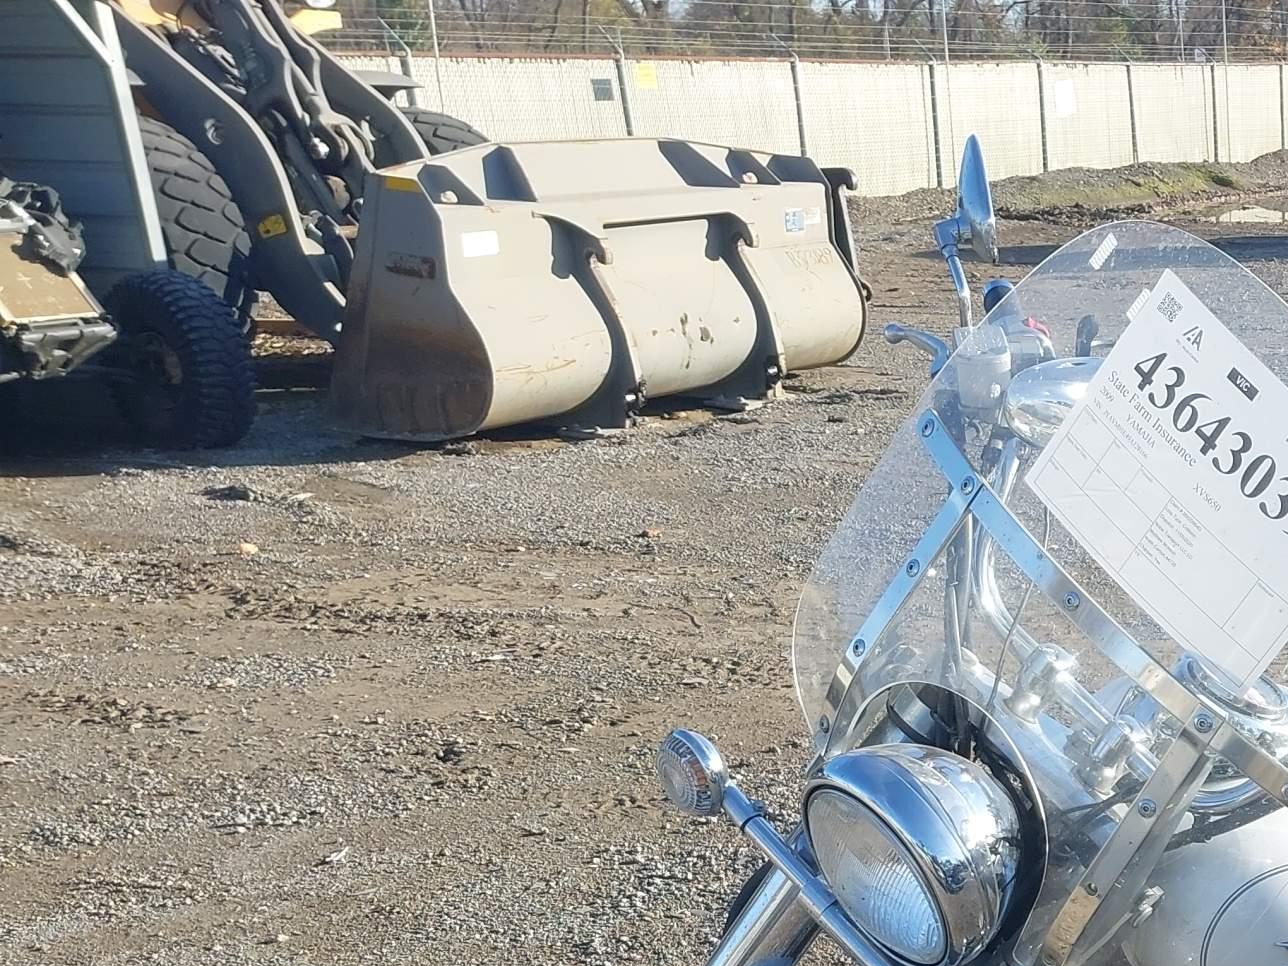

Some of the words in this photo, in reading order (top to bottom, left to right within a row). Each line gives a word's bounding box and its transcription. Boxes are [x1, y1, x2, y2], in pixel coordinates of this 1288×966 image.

[1236, 375, 1251, 391] VIC
[1107, 370, 1130, 397] State
[1128, 393, 1153, 423] Farm
[1151, 417, 1199, 467] Insurance
[1126, 413, 1156, 448] YAMAHA
